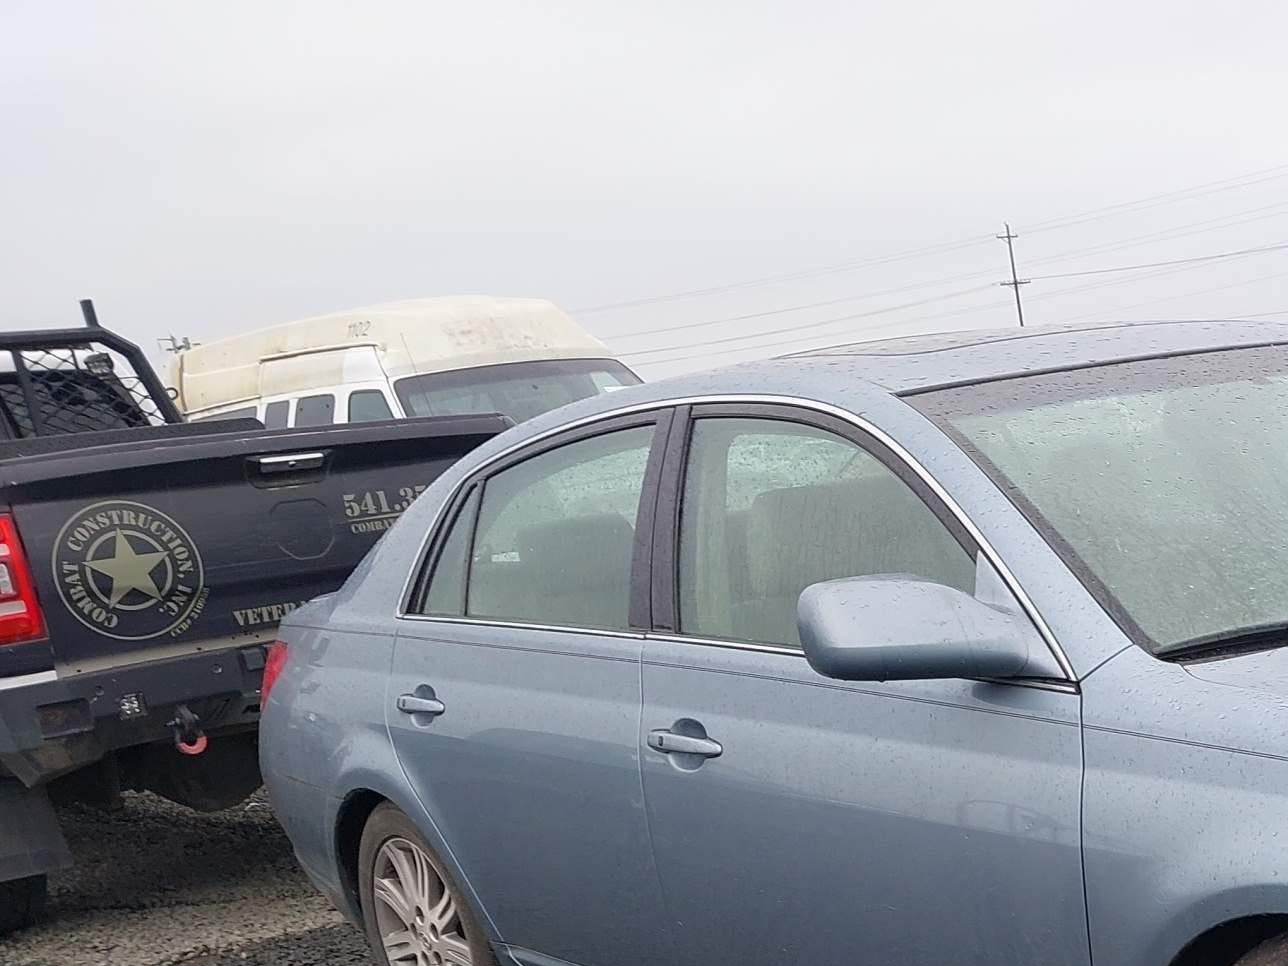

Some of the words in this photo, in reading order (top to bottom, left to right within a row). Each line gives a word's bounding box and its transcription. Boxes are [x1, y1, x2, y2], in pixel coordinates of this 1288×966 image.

[66, 510, 194, 579] CONSTRUCTION,
[61, 560, 119, 629] COMBAT
[158, 584, 193, 617] INC.
